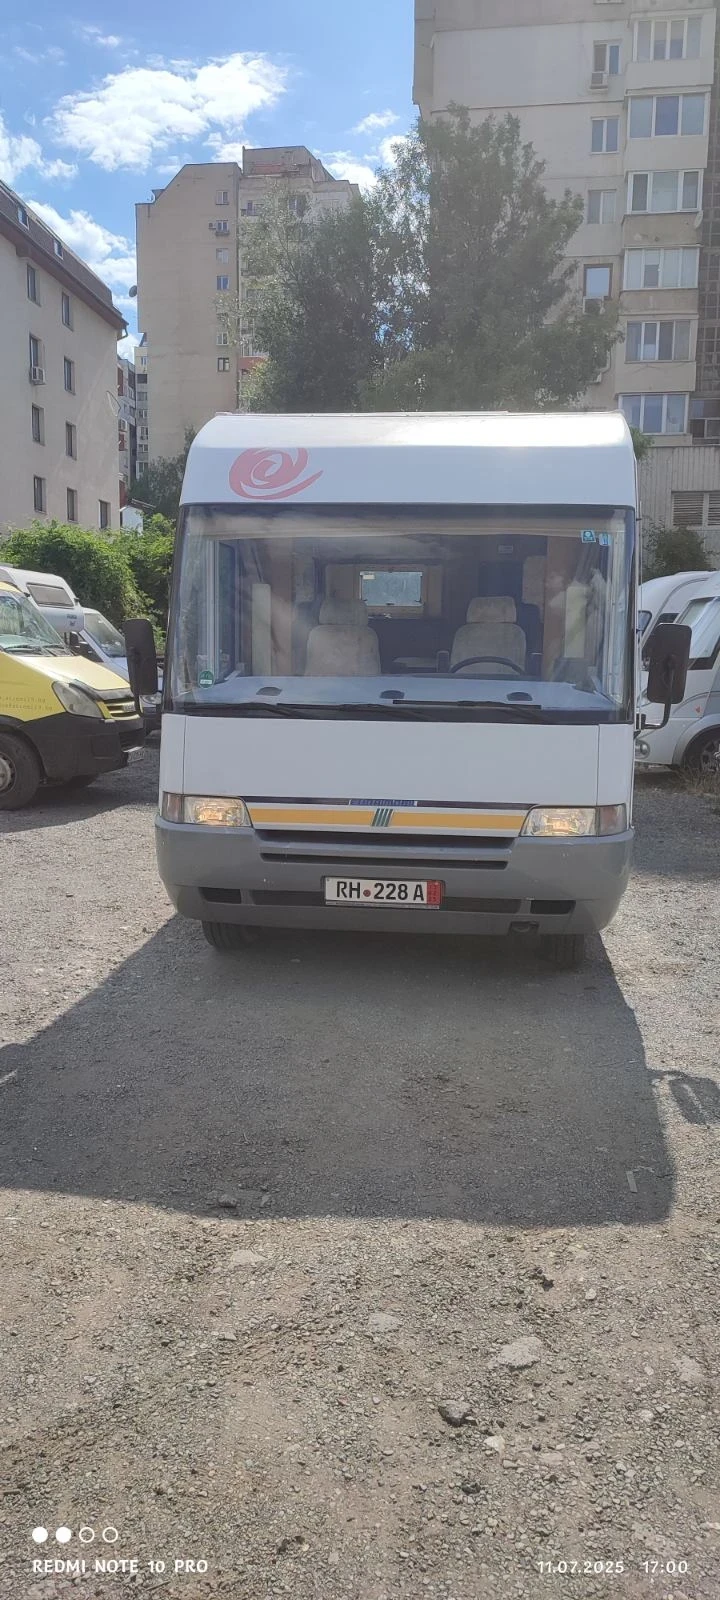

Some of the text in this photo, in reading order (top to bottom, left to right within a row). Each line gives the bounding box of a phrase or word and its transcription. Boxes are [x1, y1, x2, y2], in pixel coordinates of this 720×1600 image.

[336, 881, 361, 899] RH
[373, 882, 408, 900] 228
[412, 884, 425, 901] A
